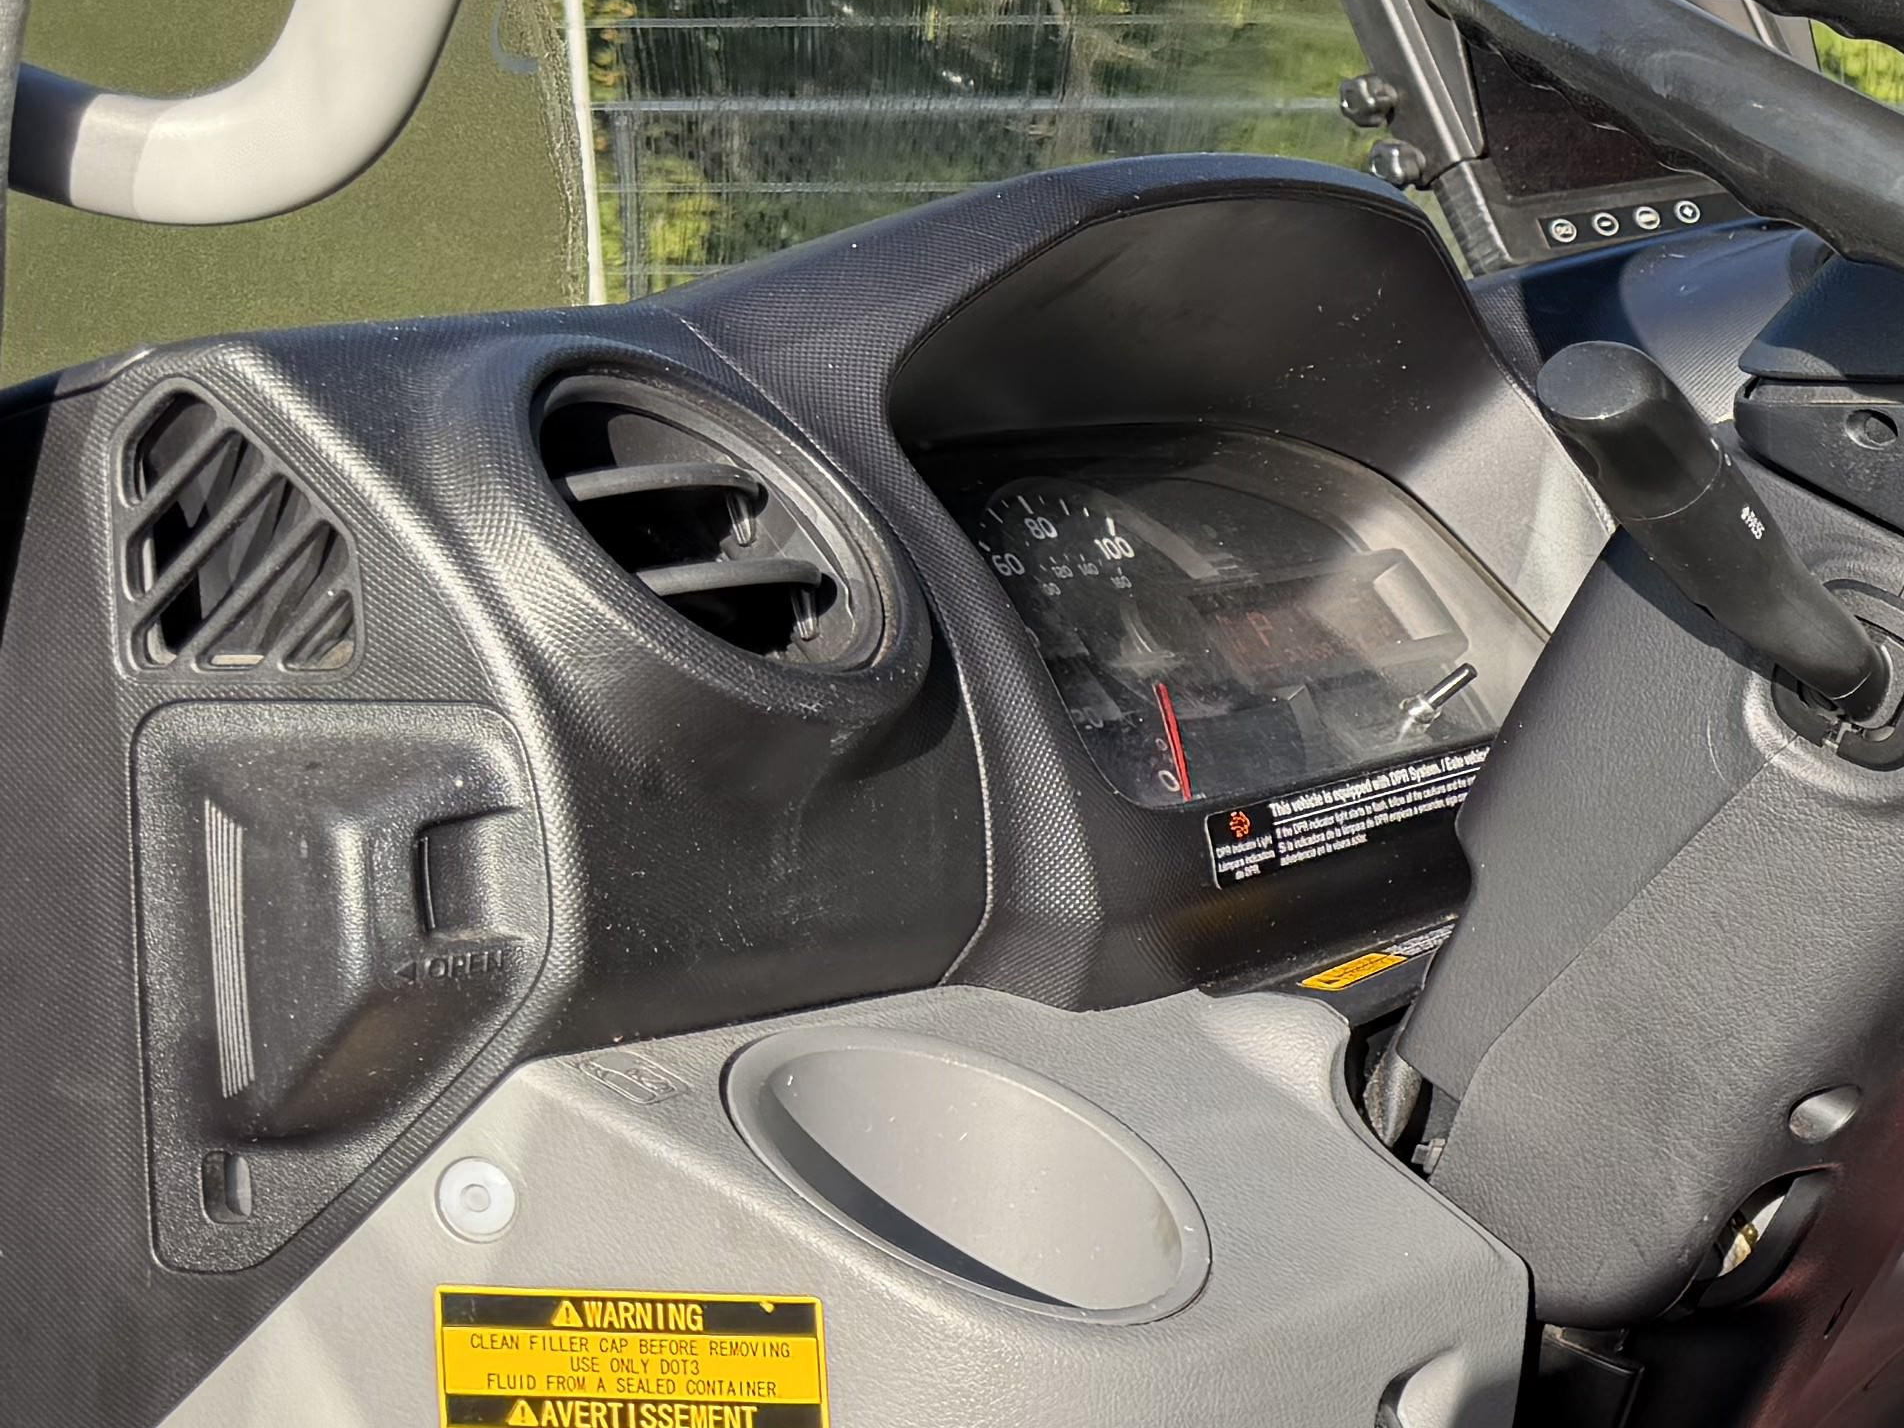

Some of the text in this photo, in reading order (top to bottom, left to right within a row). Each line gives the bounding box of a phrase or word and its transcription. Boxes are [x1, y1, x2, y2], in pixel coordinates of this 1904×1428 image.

[1024, 517, 1058, 539] 80
[1094, 536, 1135, 560] 100
[992, 553, 1025, 576] 60
[1267, 799, 1292, 818] This
[424, 949, 502, 979] OPEN
[582, 1300, 704, 1331] WARNING
[469, 1331, 791, 1359] CLEAN FILLER CAP BEFORE REMOVING
[569, 1354, 700, 1376] USE ONLY DOT3
[486, 1371, 777, 1398] FLUID FROM A SEALED CONTAINER
